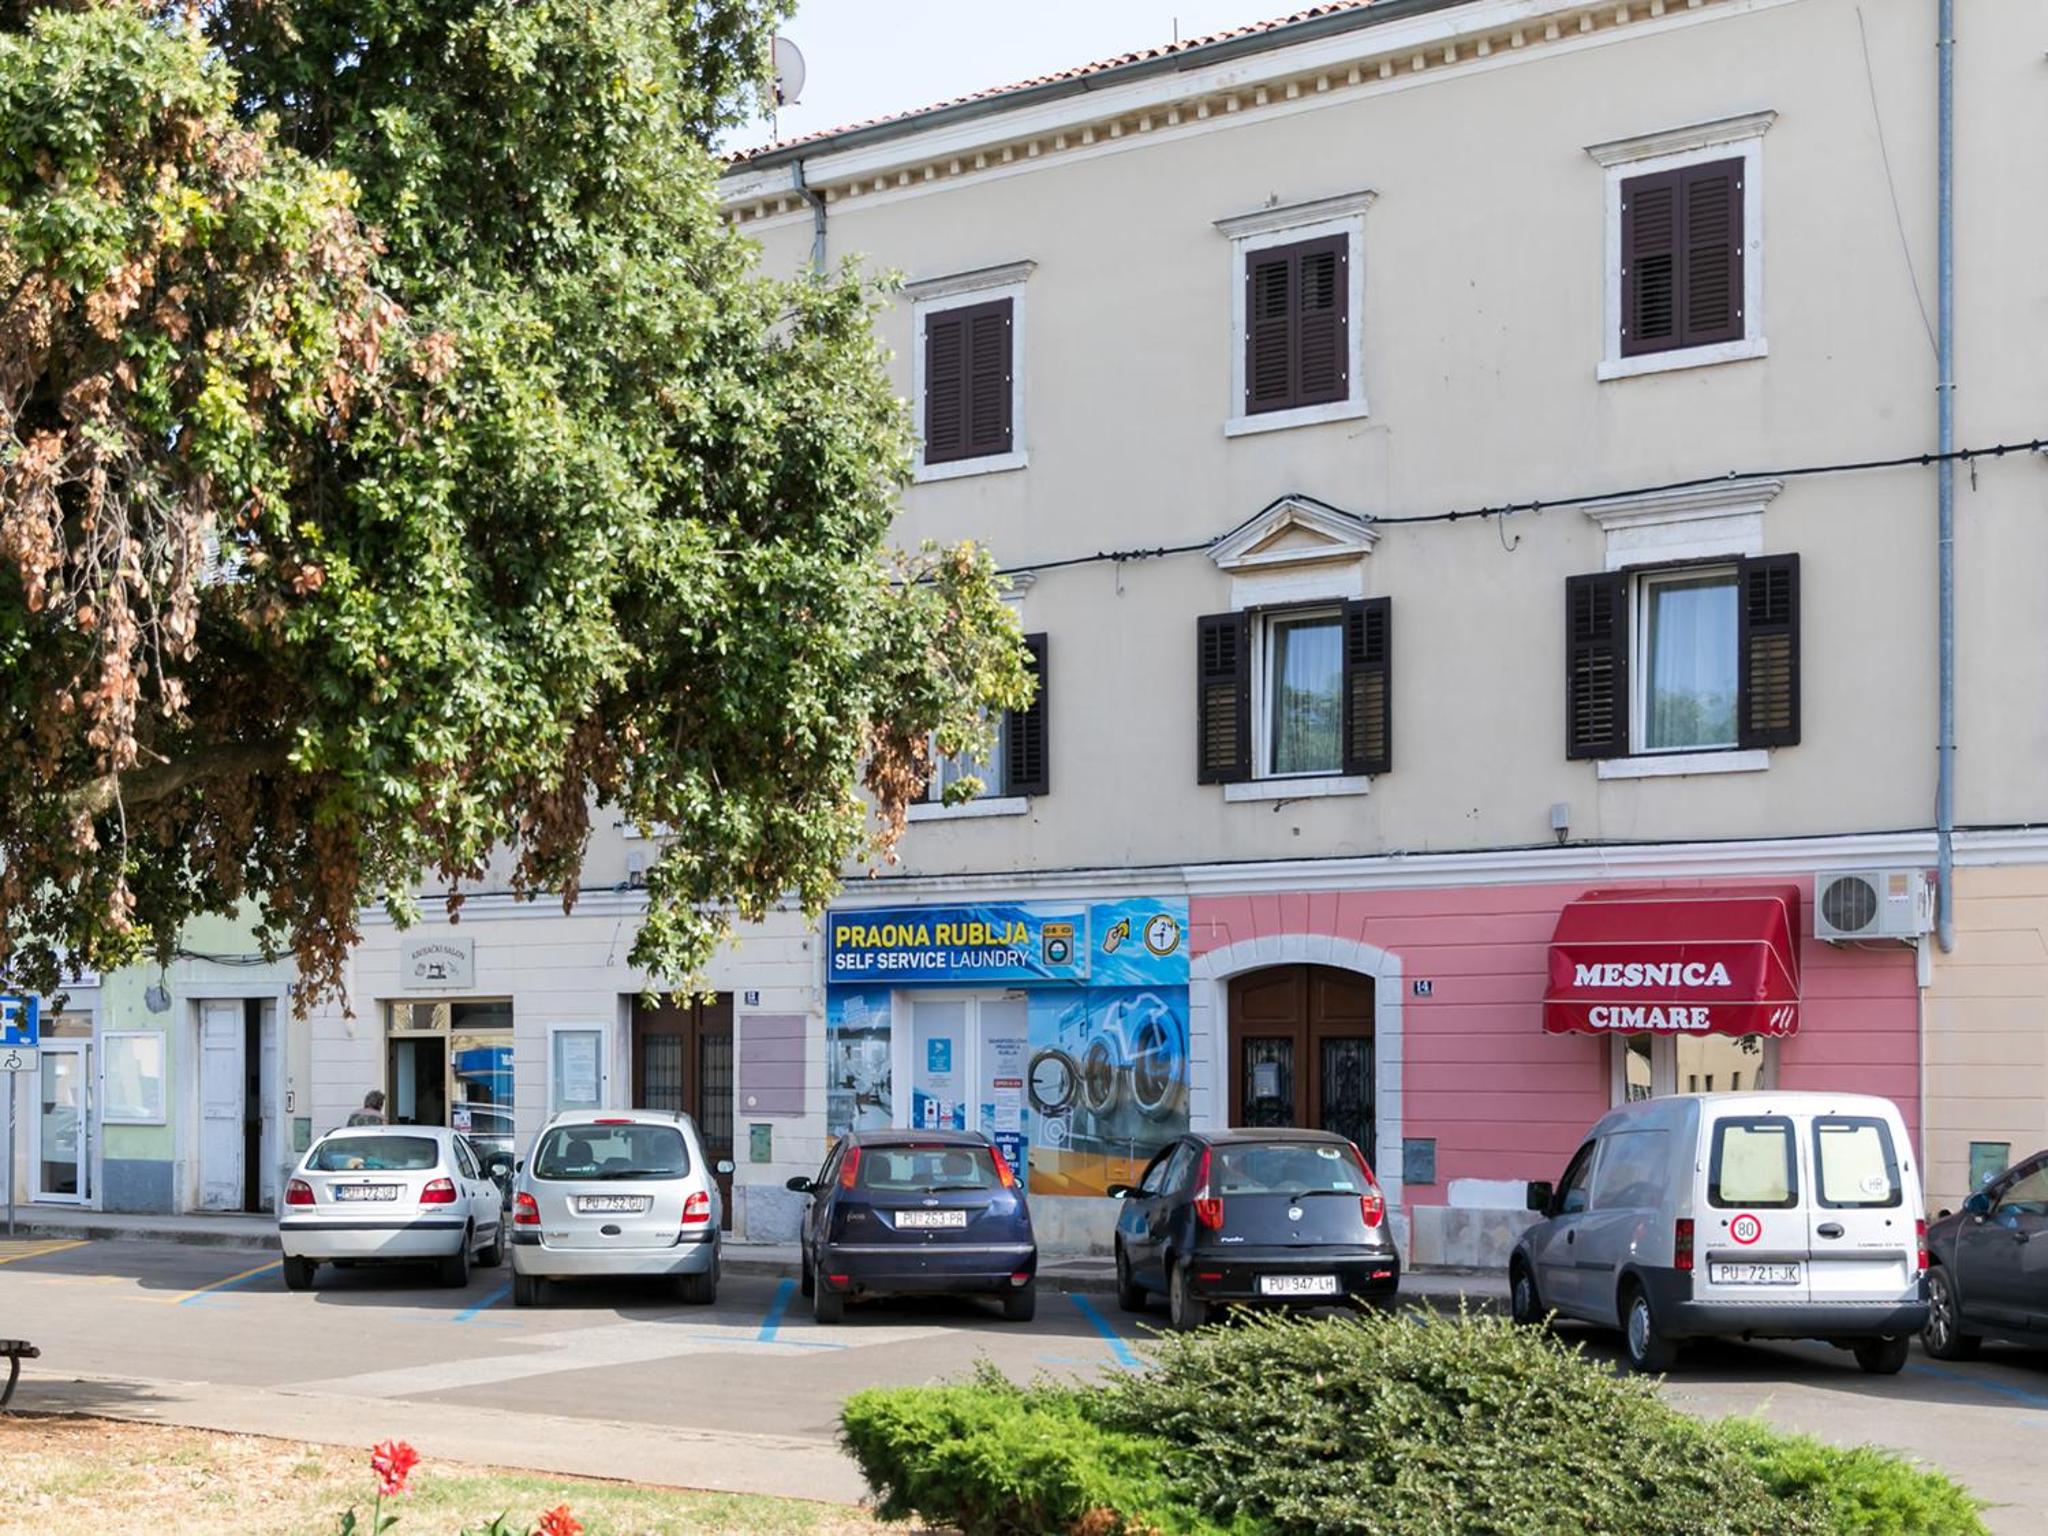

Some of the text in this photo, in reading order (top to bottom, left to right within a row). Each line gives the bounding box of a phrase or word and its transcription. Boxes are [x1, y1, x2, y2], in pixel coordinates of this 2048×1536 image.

[836, 921, 1029, 948] PRAONA RUBLJA
[835, 950, 1029, 969] SELF SERVICE LAUNDRY
[1573, 962, 1731, 987] MESNICA
[1417, 980, 1429, 991] 14
[1588, 1006, 1710, 1029] CIMARE
[586, 1197, 599, 1209] PU
[903, 1213, 916, 1225] PU
[1737, 1222, 1754, 1237] 80
[1721, 1267, 1739, 1280] PU
[1269, 1278, 1284, 1291] PU
